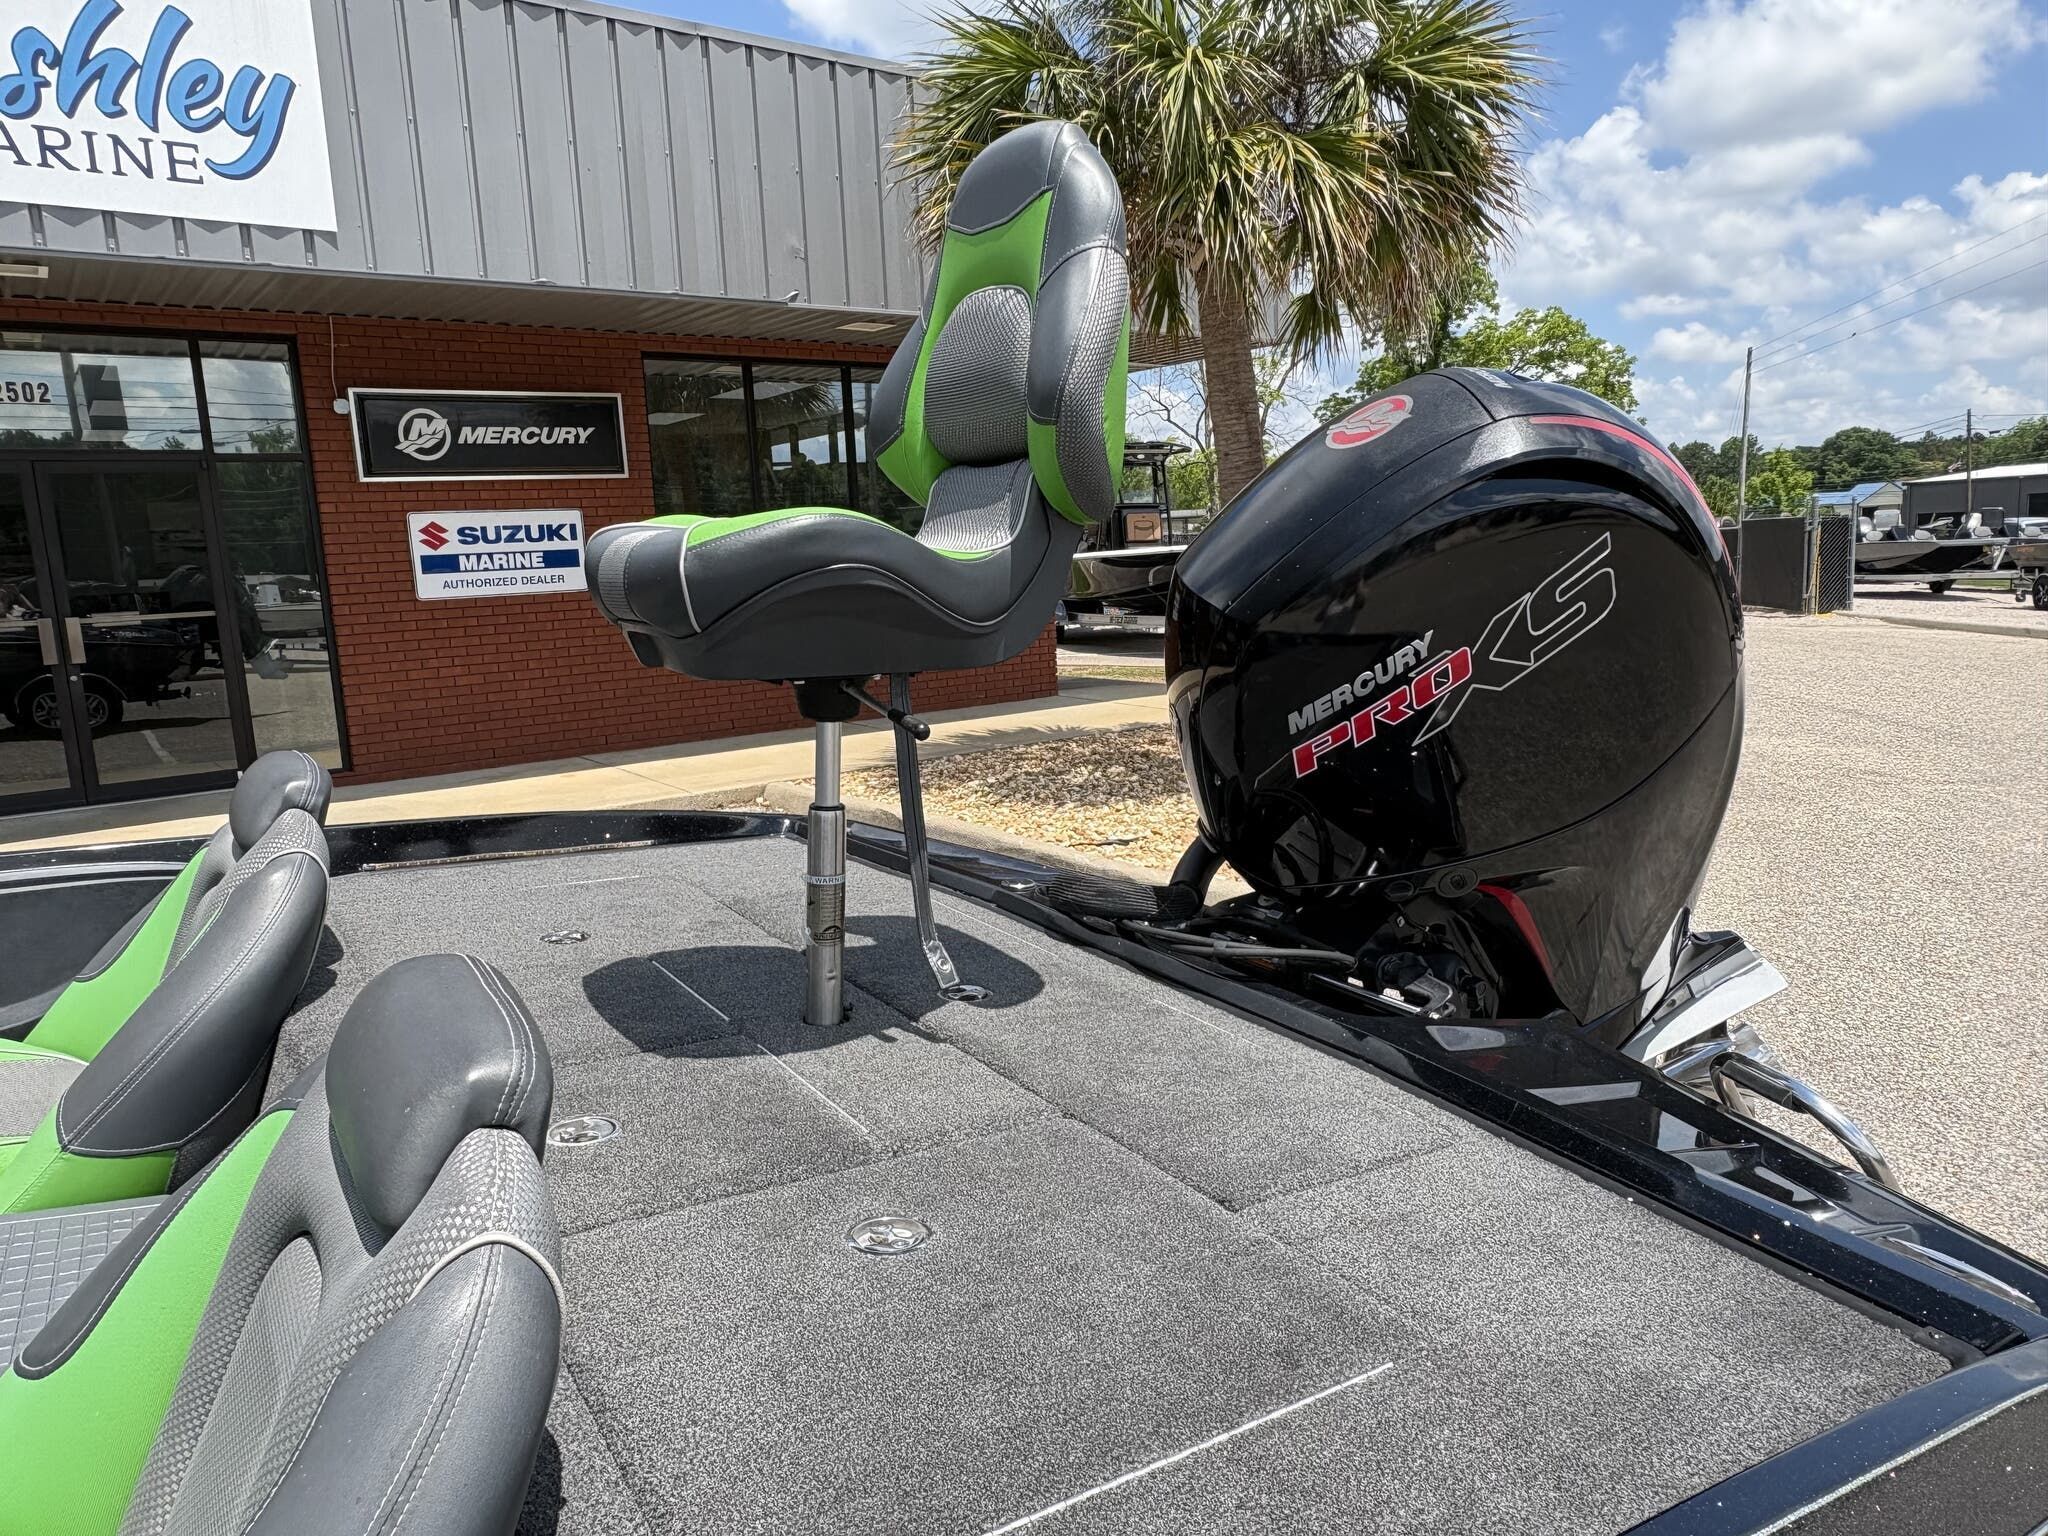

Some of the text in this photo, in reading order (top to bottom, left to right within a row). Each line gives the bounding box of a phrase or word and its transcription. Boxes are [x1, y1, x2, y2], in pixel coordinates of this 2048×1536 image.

[458, 426, 595, 445] MERCURY
[457, 523, 578, 545] SUZUKI
[459, 552, 545, 572] MARINE
[443, 574, 565, 590] AUTHORIZED DEALER
[1287, 629, 1434, 735] MERCURY
[1292, 646, 1473, 778] PRO
